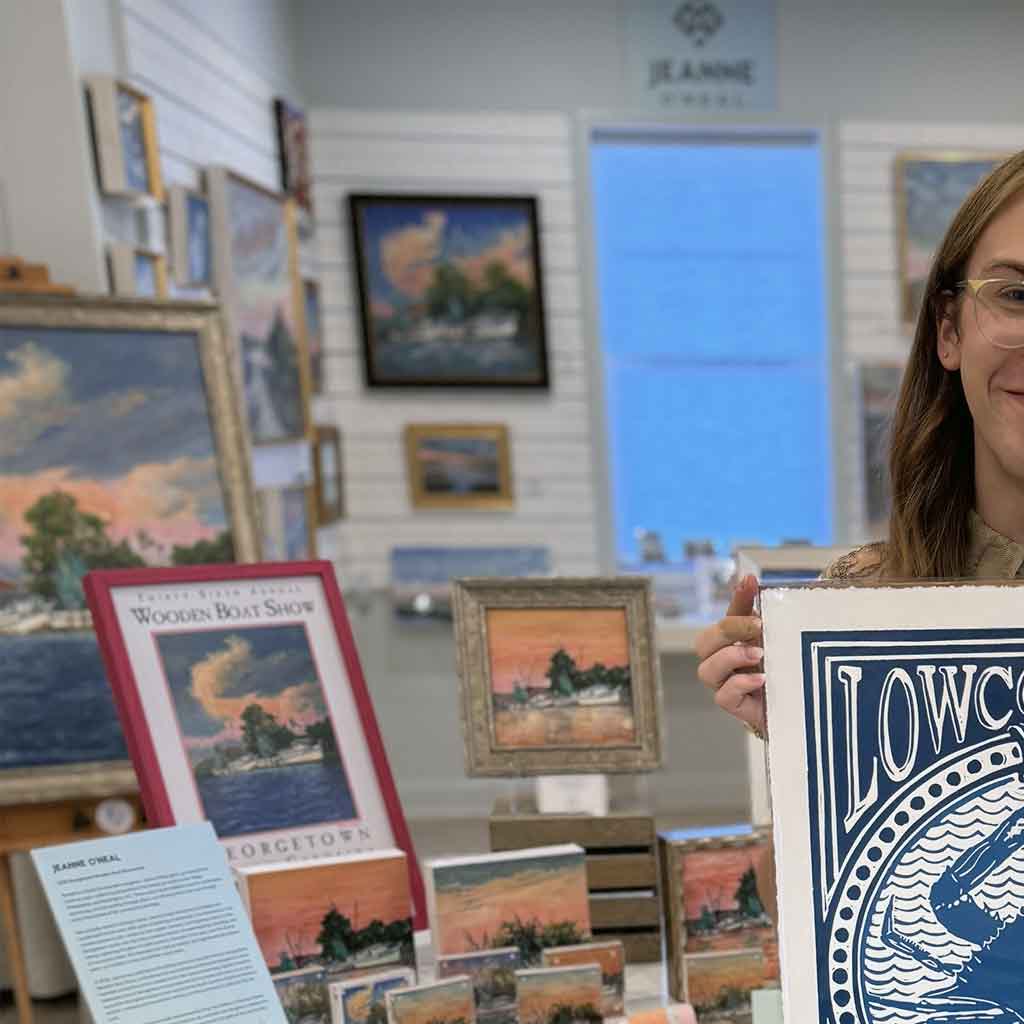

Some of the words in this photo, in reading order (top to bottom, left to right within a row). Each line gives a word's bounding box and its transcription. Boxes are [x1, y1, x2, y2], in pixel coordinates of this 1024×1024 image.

[131, 606, 212, 625] WOODEN
[213, 602, 260, 620] BOAT
[263, 598, 314, 617] SHOW
[226, 827, 372, 861] EORGETOWN
